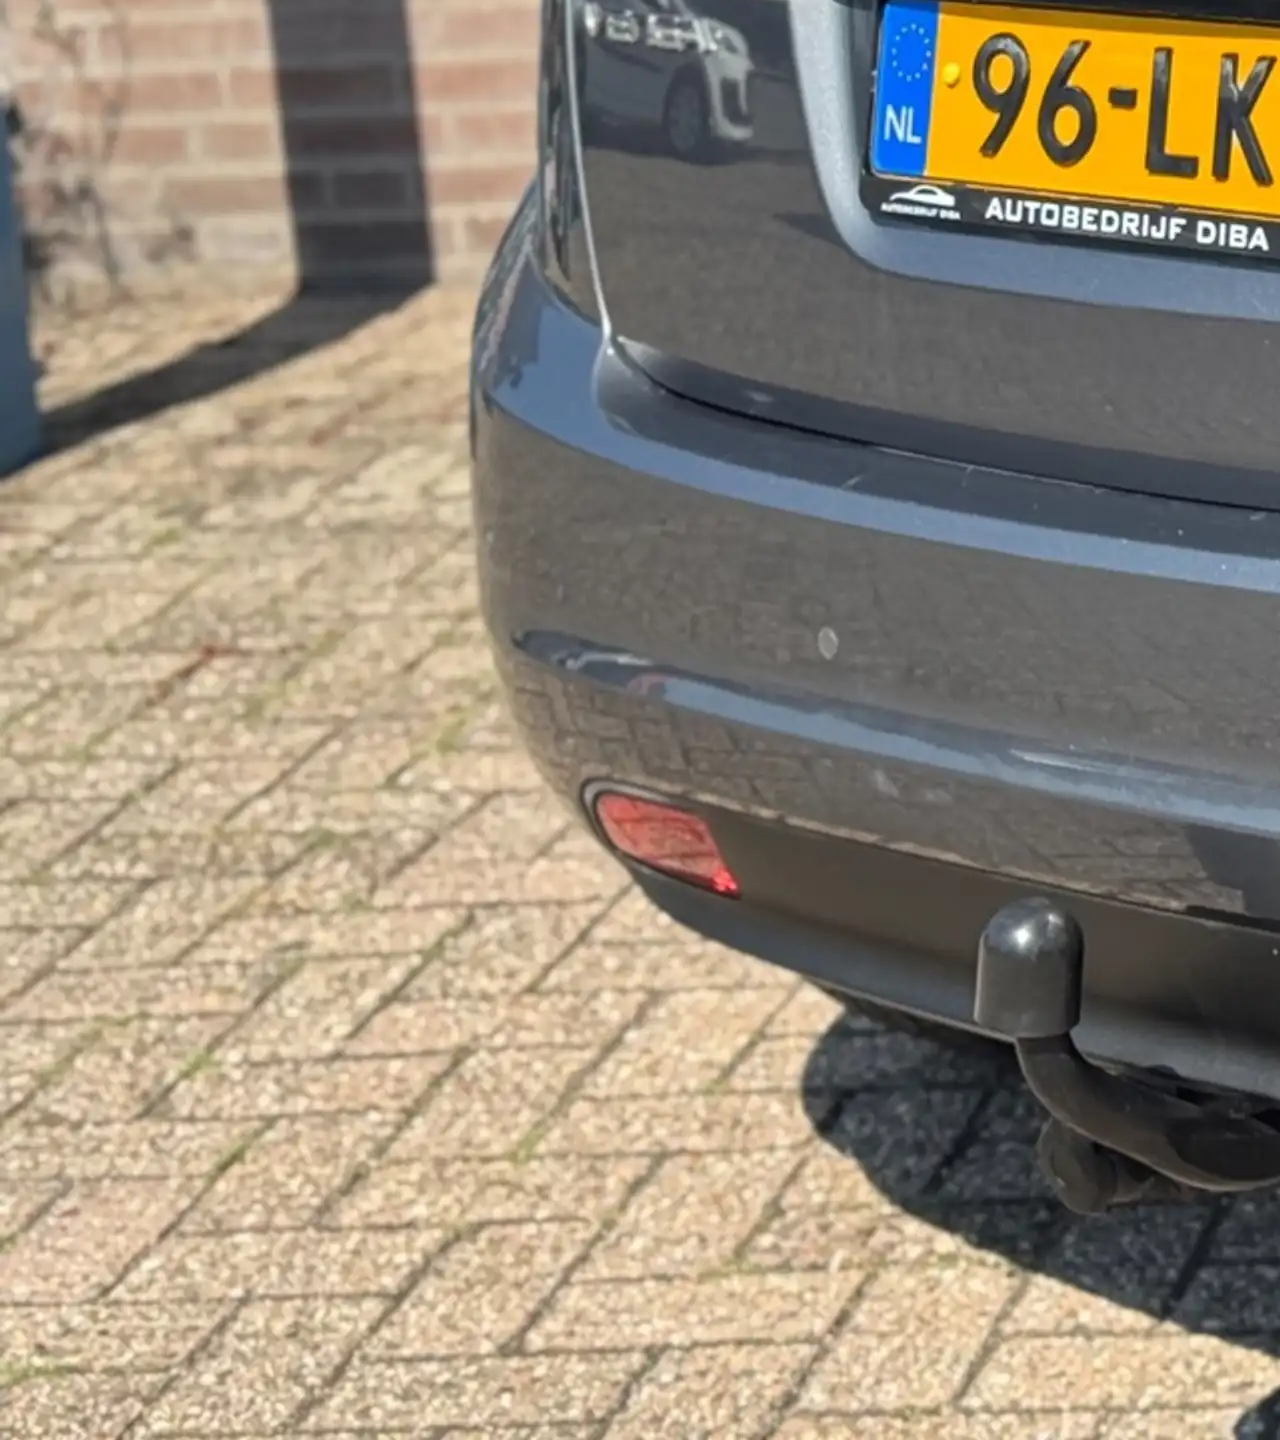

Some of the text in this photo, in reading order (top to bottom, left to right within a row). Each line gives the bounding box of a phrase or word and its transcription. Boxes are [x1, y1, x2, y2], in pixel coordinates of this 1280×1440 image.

[883, 105, 924, 144] NL
[984, 197, 1270, 251] AUTOBEDRIJF DIBA
